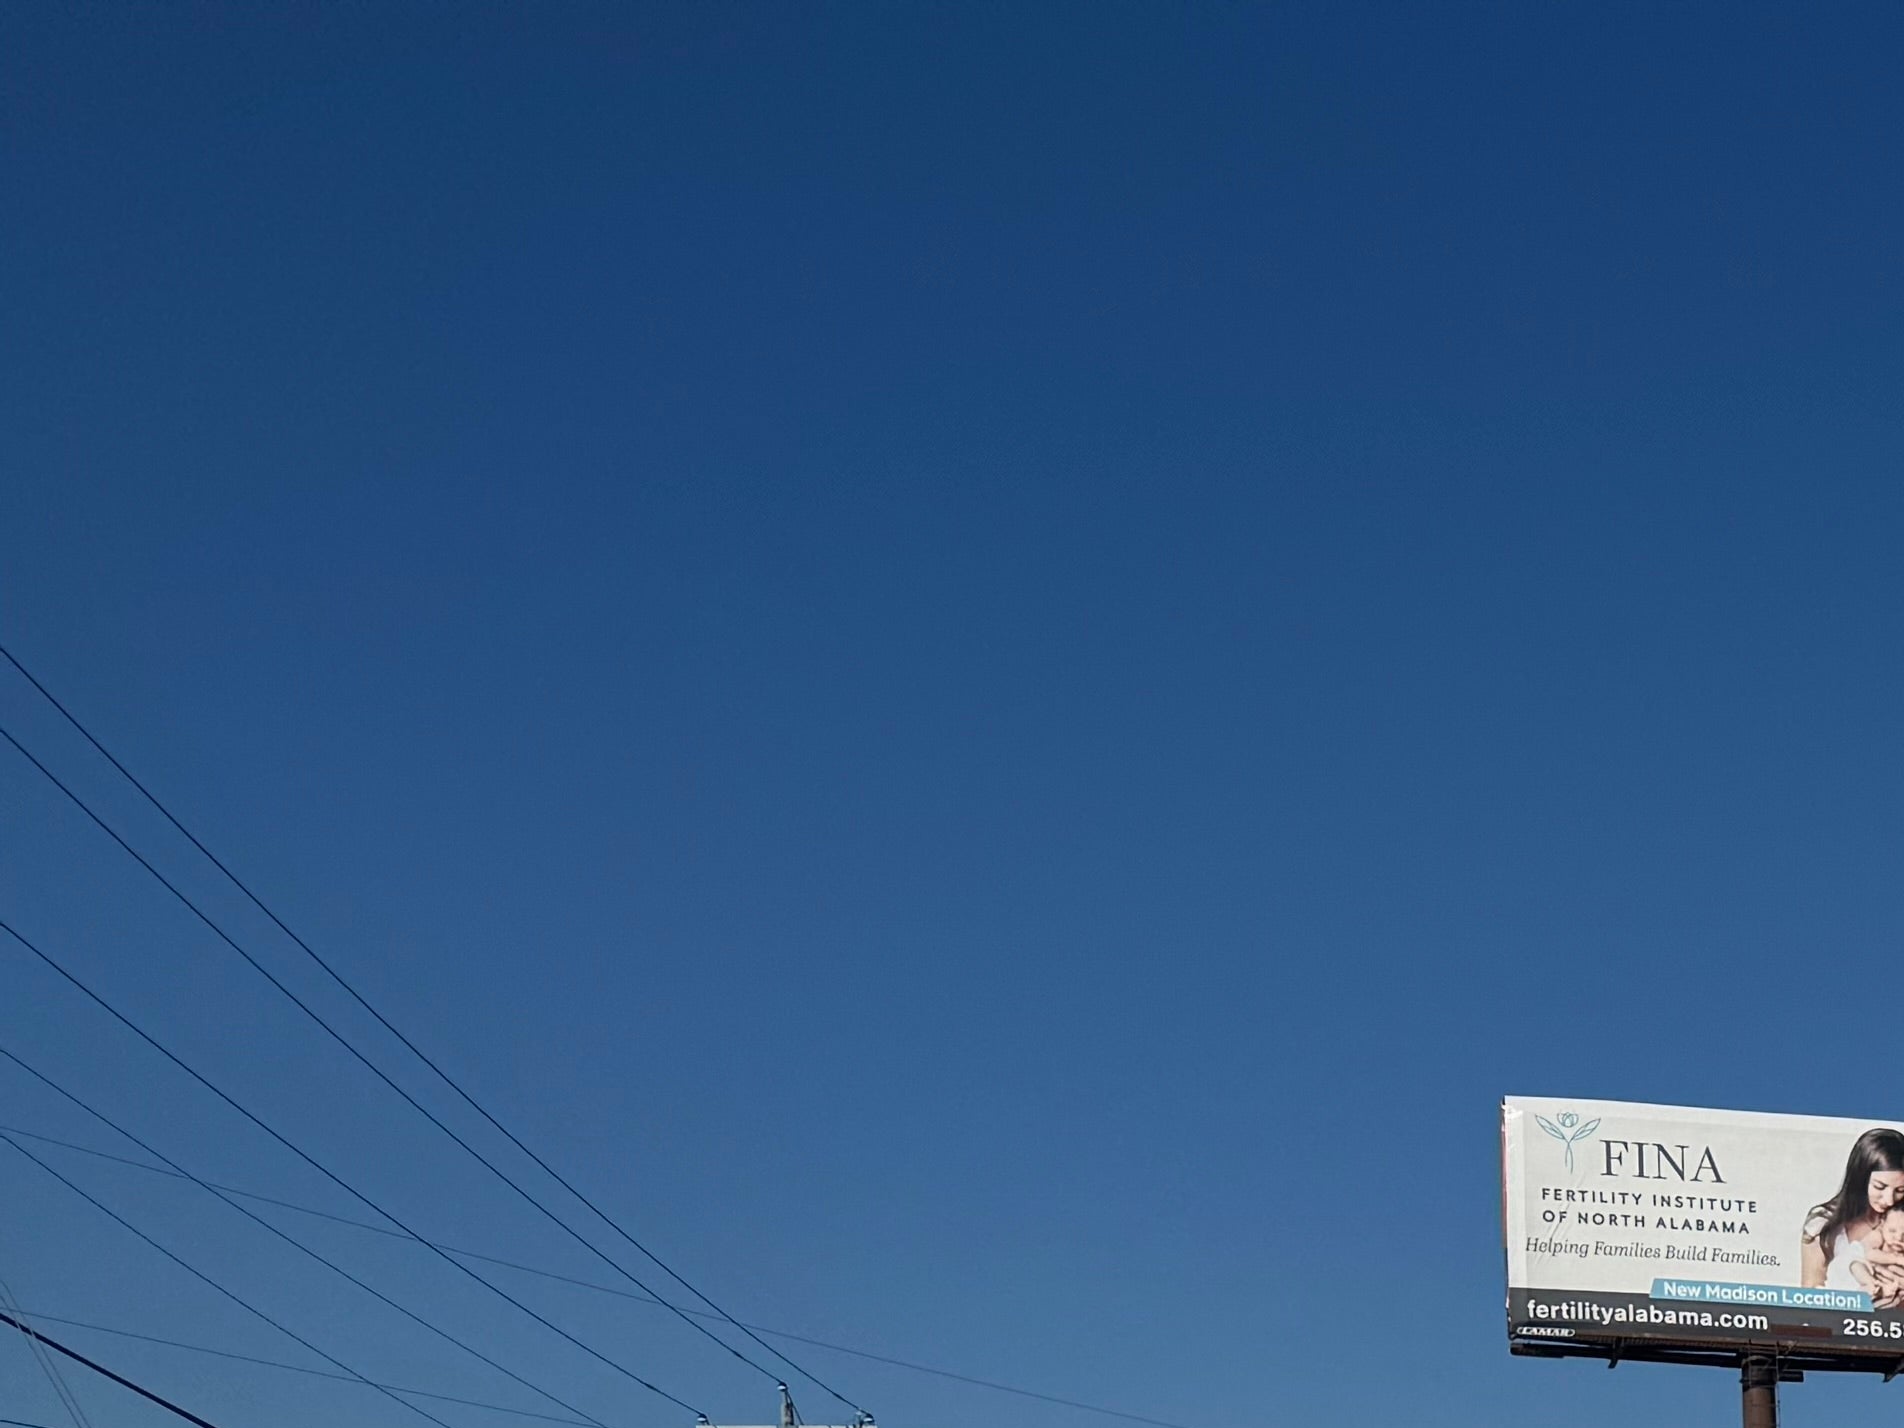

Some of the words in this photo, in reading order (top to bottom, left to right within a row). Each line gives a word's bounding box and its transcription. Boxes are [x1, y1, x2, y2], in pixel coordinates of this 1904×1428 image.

[1599, 1139, 1727, 1184] FINA
[1542, 1188, 1642, 1206] FERTILITY
[1652, 1194, 1757, 1213] INSTITUTE
[1542, 1210, 1567, 1223] OF
[1578, 1212, 1645, 1228] NORTH
[1656, 1217, 1750, 1235] ALABAMA
[1525, 1237, 1589, 1258] Helping
[1594, 1241, 1661, 1259] Families
[1665, 1245, 1707, 1262] Build
[1711, 1248, 1781, 1266] Families.
[1663, 1281, 1701, 1298] New
[1705, 1283, 1778, 1303] Madison
[1782, 1290, 1861, 1309] Location!
[1527, 1299, 1768, 1330] fertilityalabama.com
